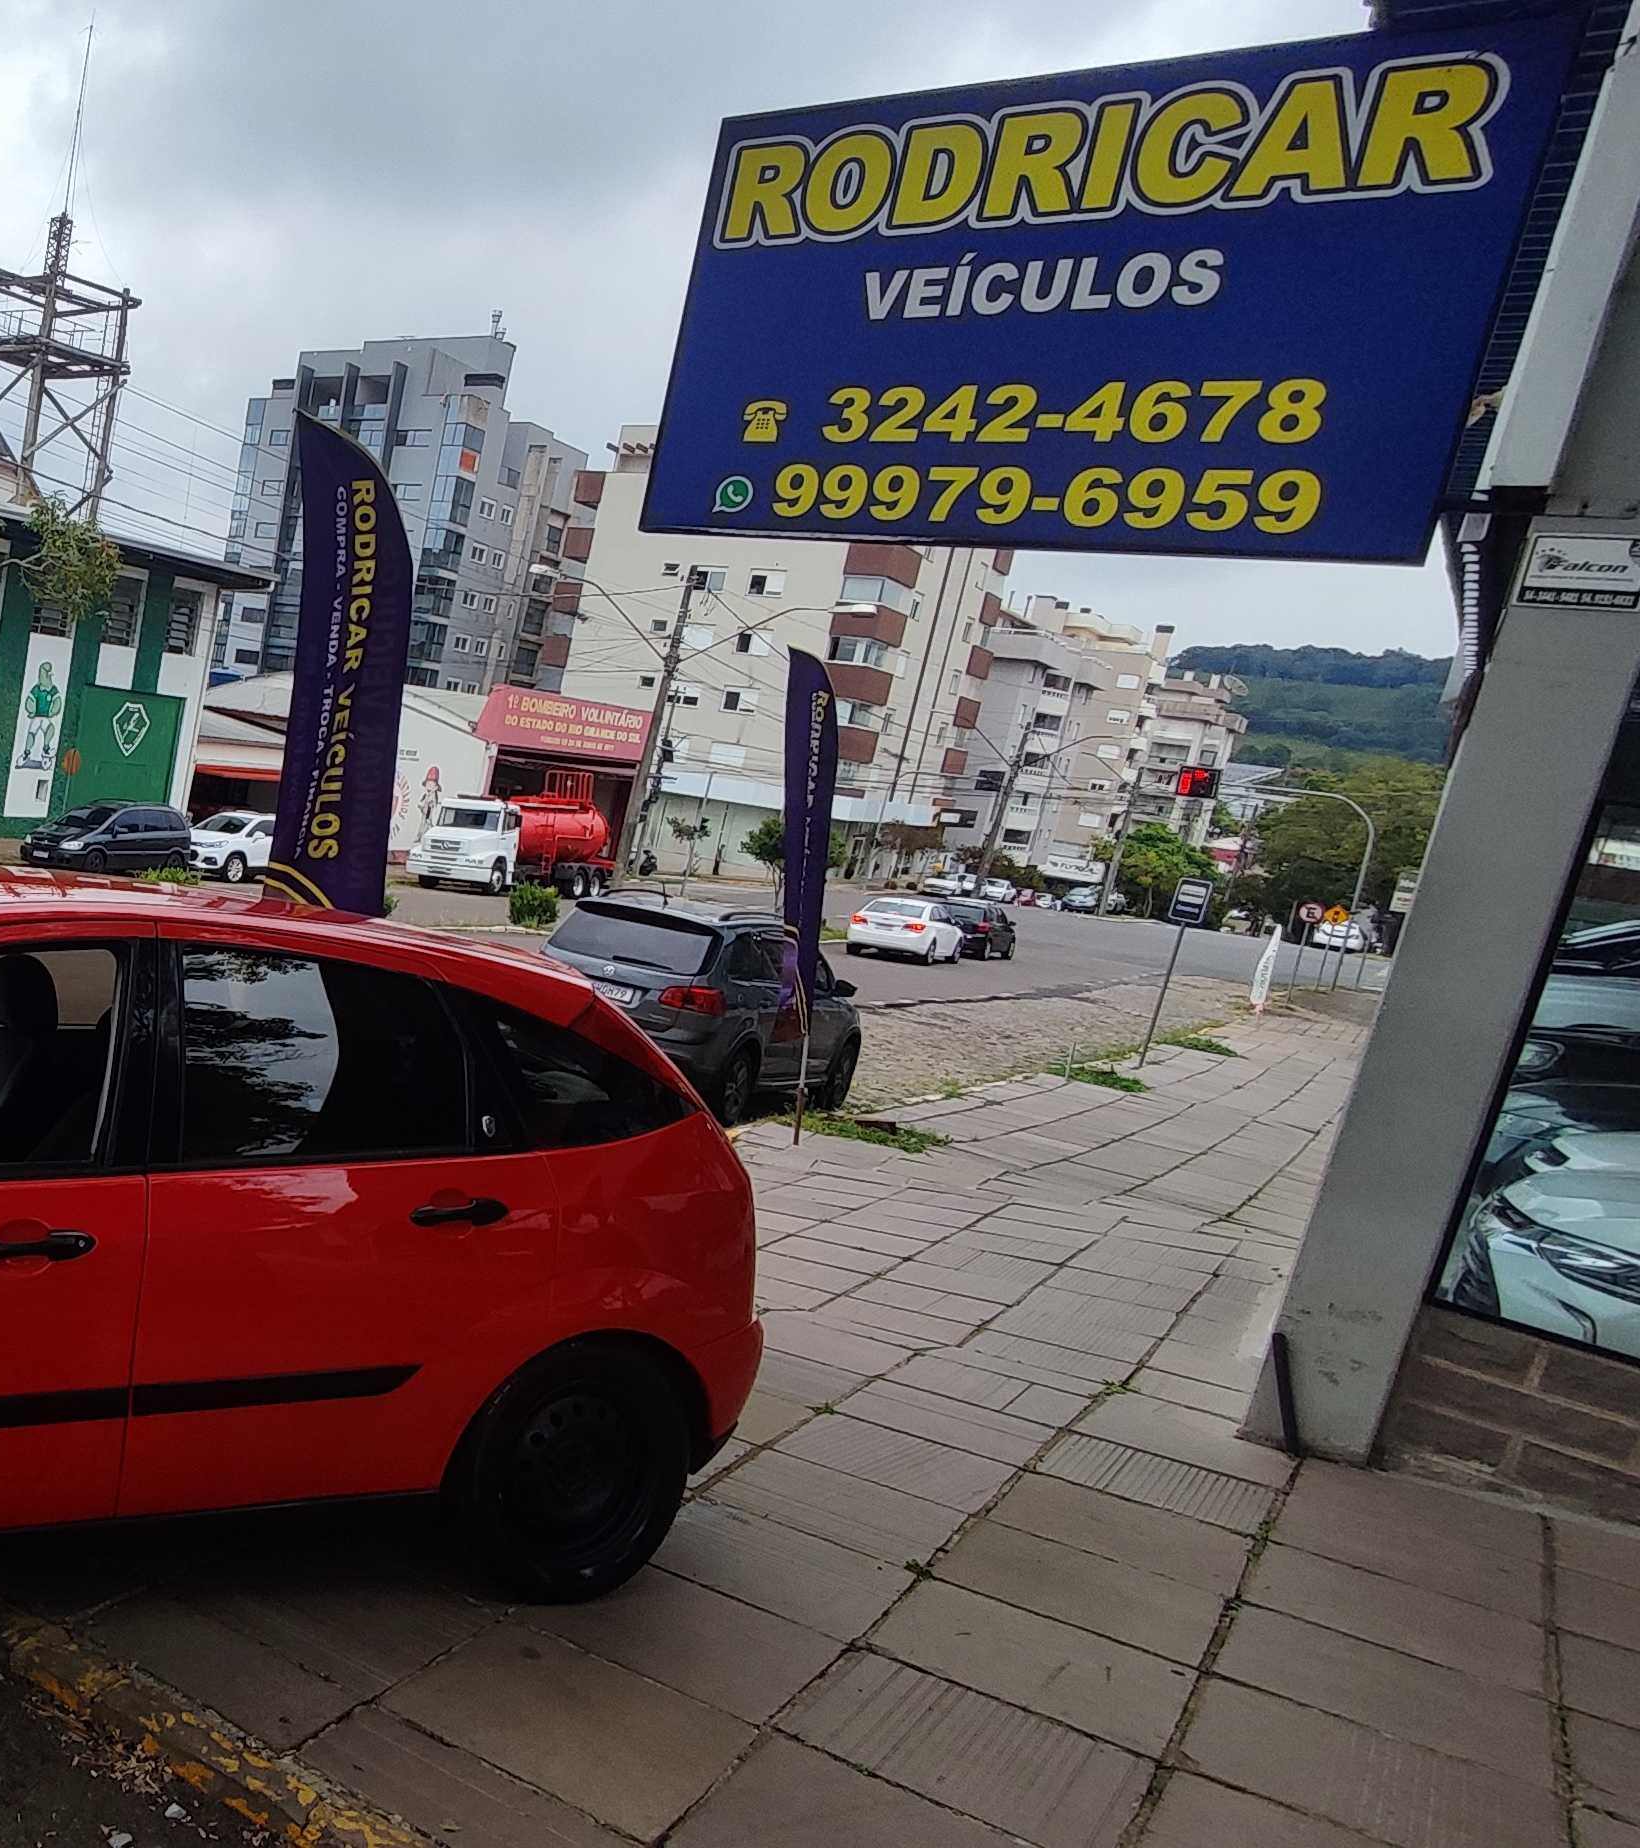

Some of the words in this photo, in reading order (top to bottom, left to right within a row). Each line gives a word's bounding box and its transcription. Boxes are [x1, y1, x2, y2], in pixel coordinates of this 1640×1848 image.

[713, 51, 1510, 249] RODRICAR
[864, 248, 1225, 321] VEÍCULOS
[821, 378, 1327, 445] 3242-4678
[335, 485, 347, 579] COMPRA
[772, 463, 1322, 535] 99979-6959
[343, 479, 377, 674] RODRICAR
[1544, 558, 1629, 574] Falcon
[326, 596, 344, 668] VENDA
[316, 684, 335, 753] TROCA
[504, 715, 519, 727] DO
[519, 717, 554, 731] ESTADO
[520, 697, 577, 719] BOMBEIRO
[308, 682, 356, 860] VEÍCULOS
